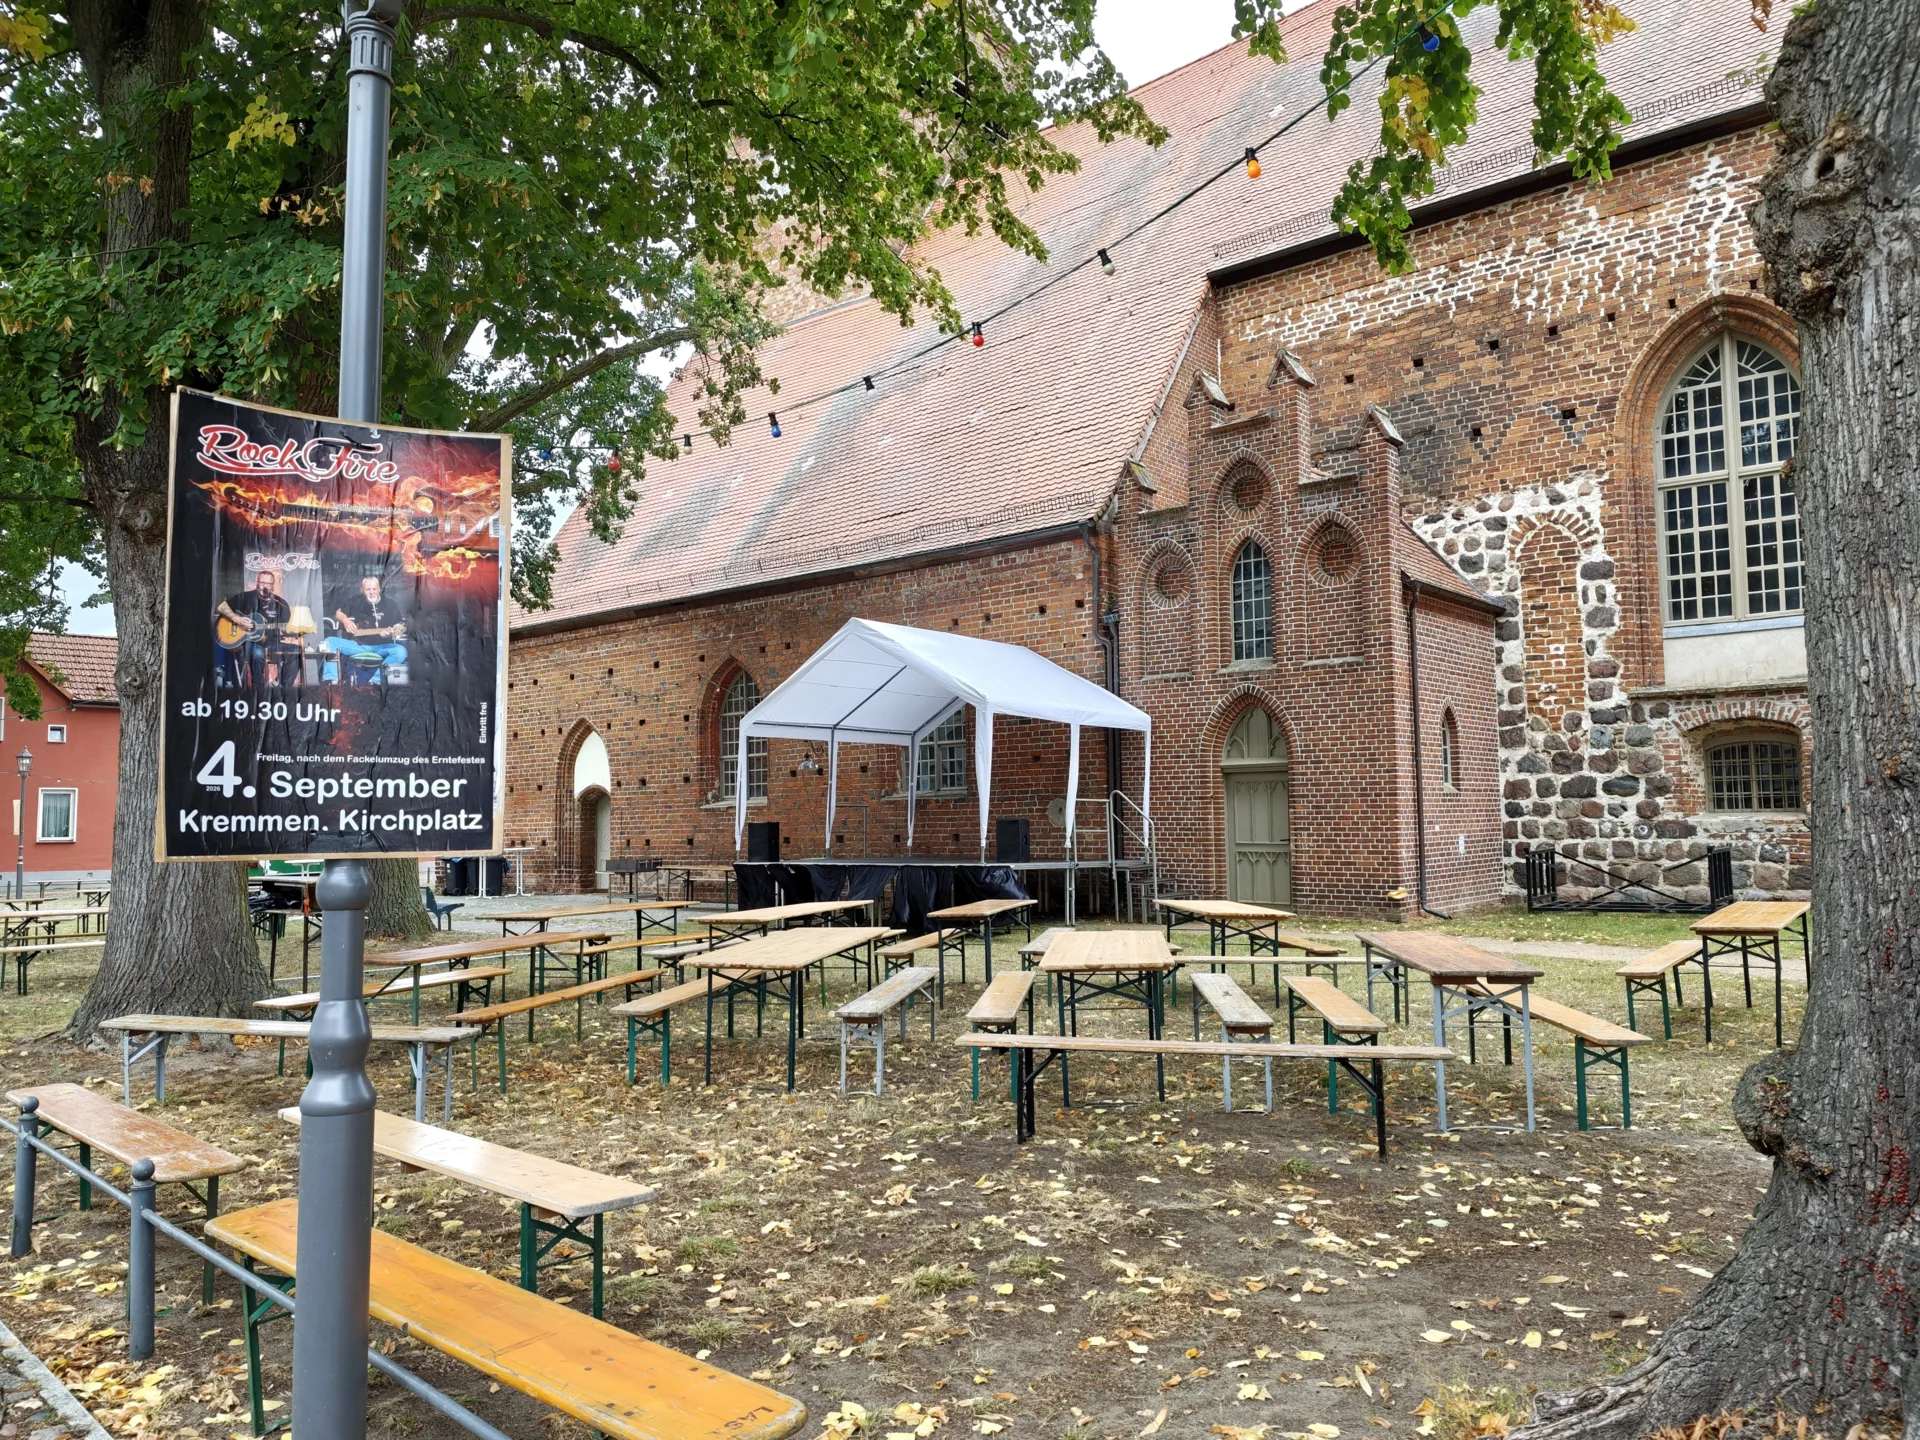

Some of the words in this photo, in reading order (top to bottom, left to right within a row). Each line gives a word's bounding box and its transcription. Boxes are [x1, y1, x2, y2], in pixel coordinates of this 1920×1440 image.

[196, 424, 302, 475] Rock
[302, 437, 400, 482] Fire
[245, 552, 283, 571] Rock
[282, 552, 321, 571] Fire
[181, 698, 212, 717] ab
[220, 699, 288, 721] 19.30
[295, 703, 341, 722] Uhr
[478, 702, 487, 715] frei
[479, 716, 487, 744] Eintritt
[256, 752, 294, 763] Freitag,
[296, 754, 321, 762] nach
[323, 754, 344, 763] dem
[347, 755, 410, 765] Fackelumzug
[412, 755, 429, 764] des
[432, 755, 485, 764] Erntefestes
[196, 740, 256, 798] 4.
[270, 770, 468, 804] September
[179, 809, 329, 833] Kremmen.
[339, 808, 483, 836] Kirchplatz
